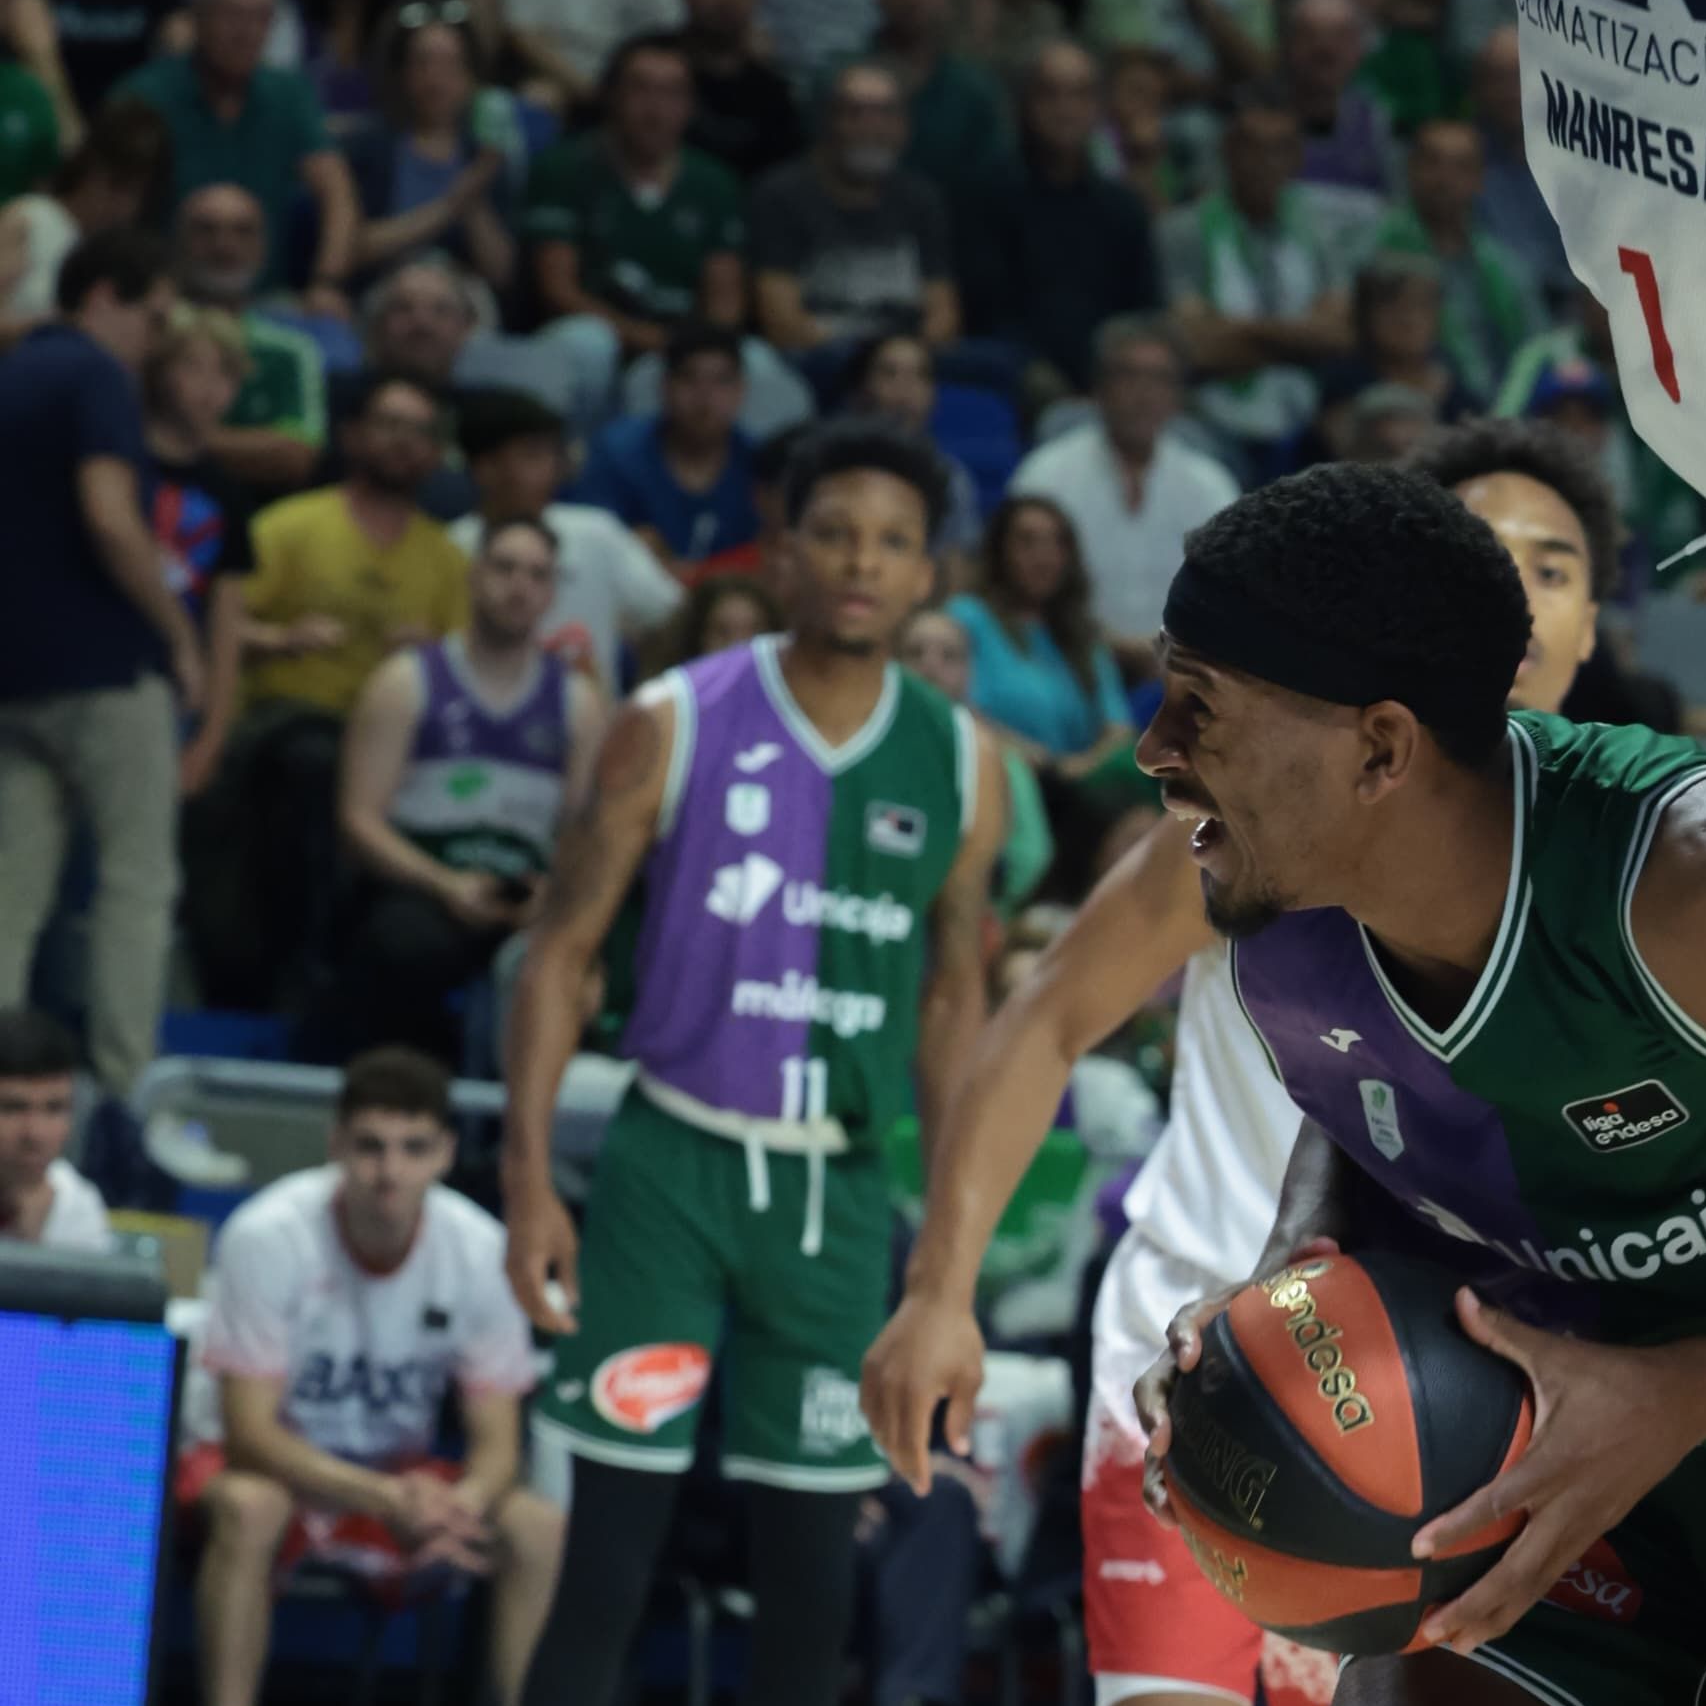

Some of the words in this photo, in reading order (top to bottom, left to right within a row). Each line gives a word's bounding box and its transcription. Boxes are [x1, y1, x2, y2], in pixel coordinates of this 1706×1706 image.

[1617, 245, 1682, 404] 1
[1582, 1113, 1625, 1133] liga
[1595, 1108, 1680, 1145] endesa
